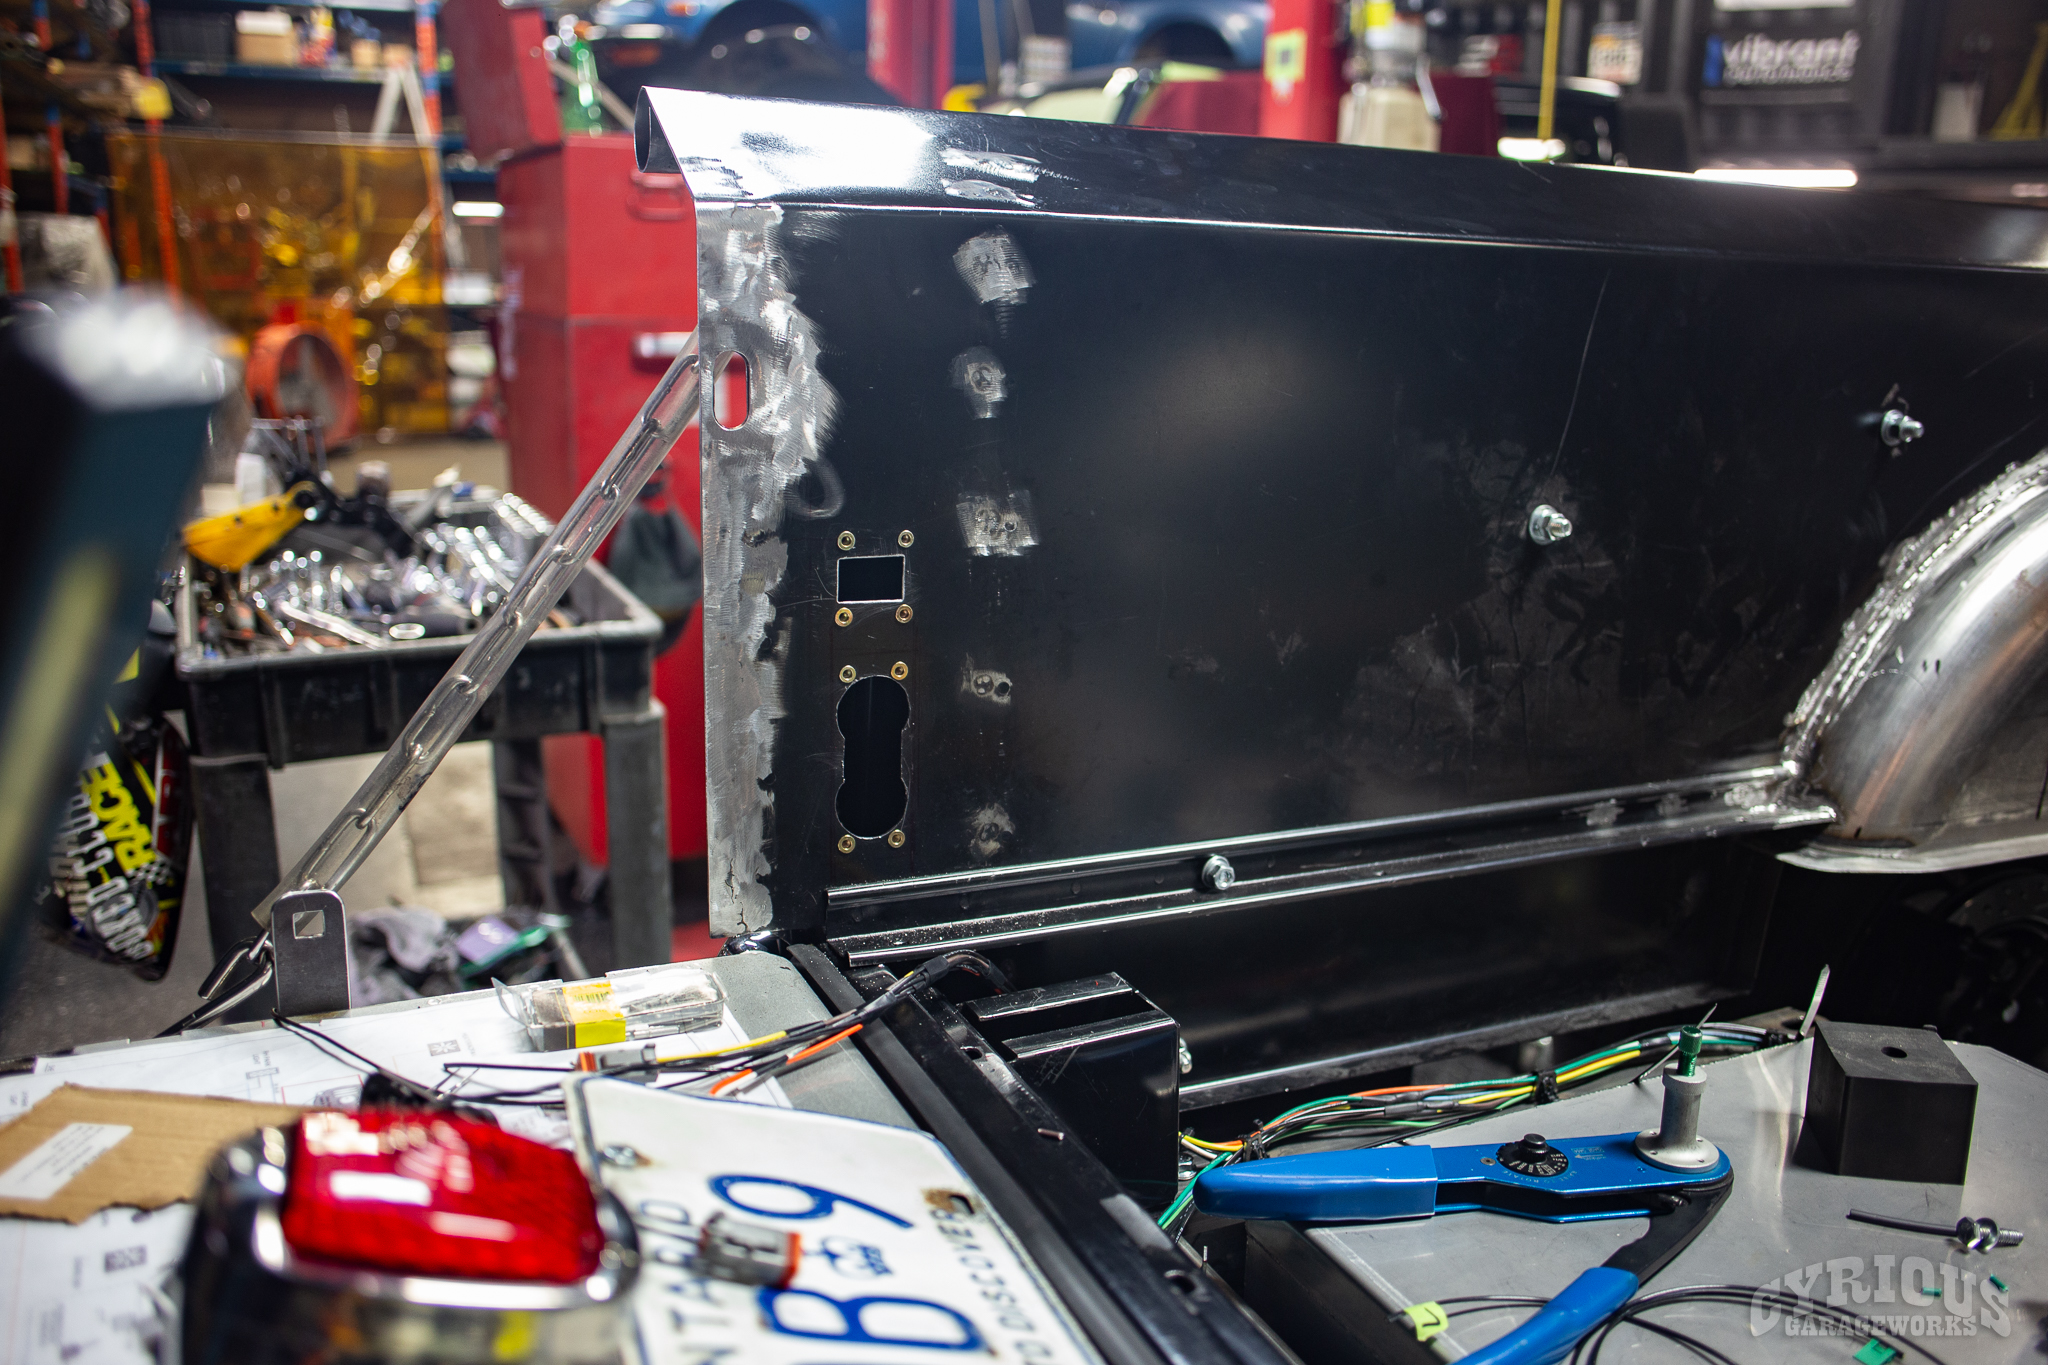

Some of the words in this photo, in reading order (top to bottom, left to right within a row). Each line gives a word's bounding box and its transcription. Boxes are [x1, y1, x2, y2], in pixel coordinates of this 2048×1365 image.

[1722, 30, 1862, 71] vibrant
[79, 762, 157, 871] RACE
[707, 1173, 915, 1230] 9
